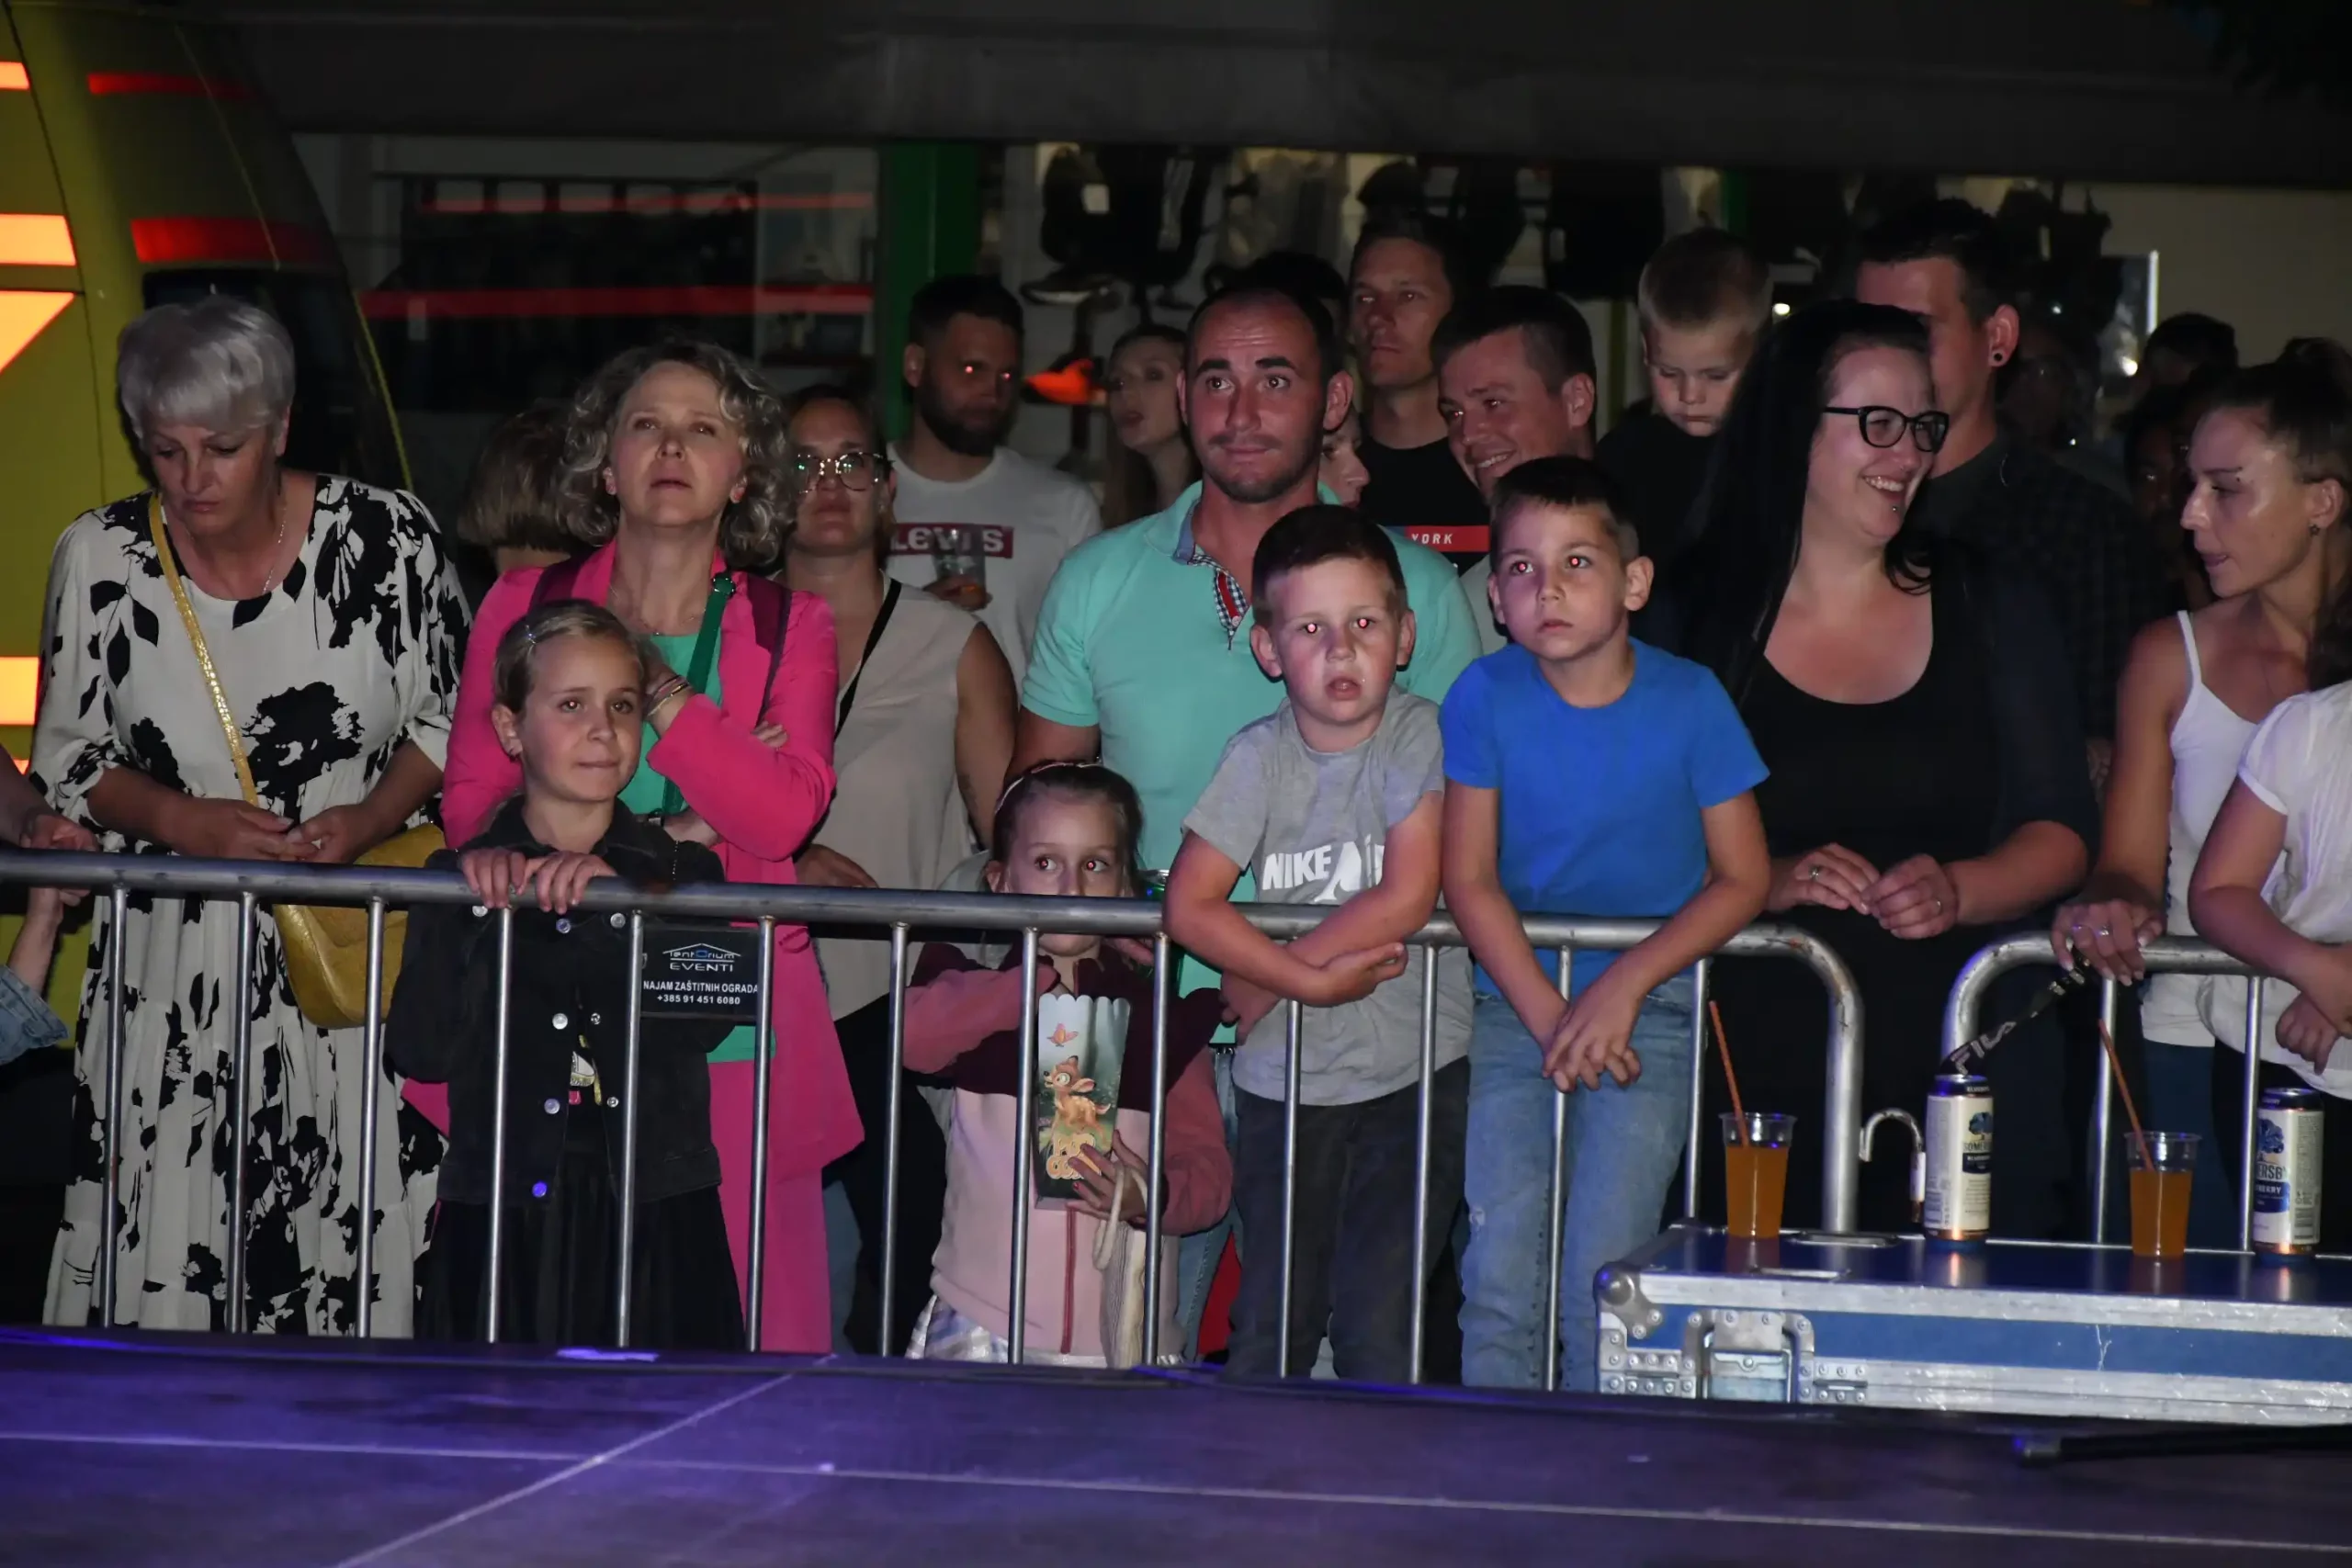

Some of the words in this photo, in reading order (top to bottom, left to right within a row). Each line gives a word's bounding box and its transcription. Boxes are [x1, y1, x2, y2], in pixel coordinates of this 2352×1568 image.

[1411, 533, 1453, 545] YORK
[1261, 844, 1332, 891] NIKE
[670, 963, 733, 972] EVENTI
[643, 980, 673, 990] NAJAM
[674, 980, 720, 992] ZAŠTITNIH
[721, 983, 758, 993] OGRADA
[657, 994, 681, 1002] +385
[683, 995, 695, 1003] 91
[696, 995, 714, 1004] 451
[717, 996, 741, 1005] 6080
[1950, 1021, 2018, 1076] FILA
